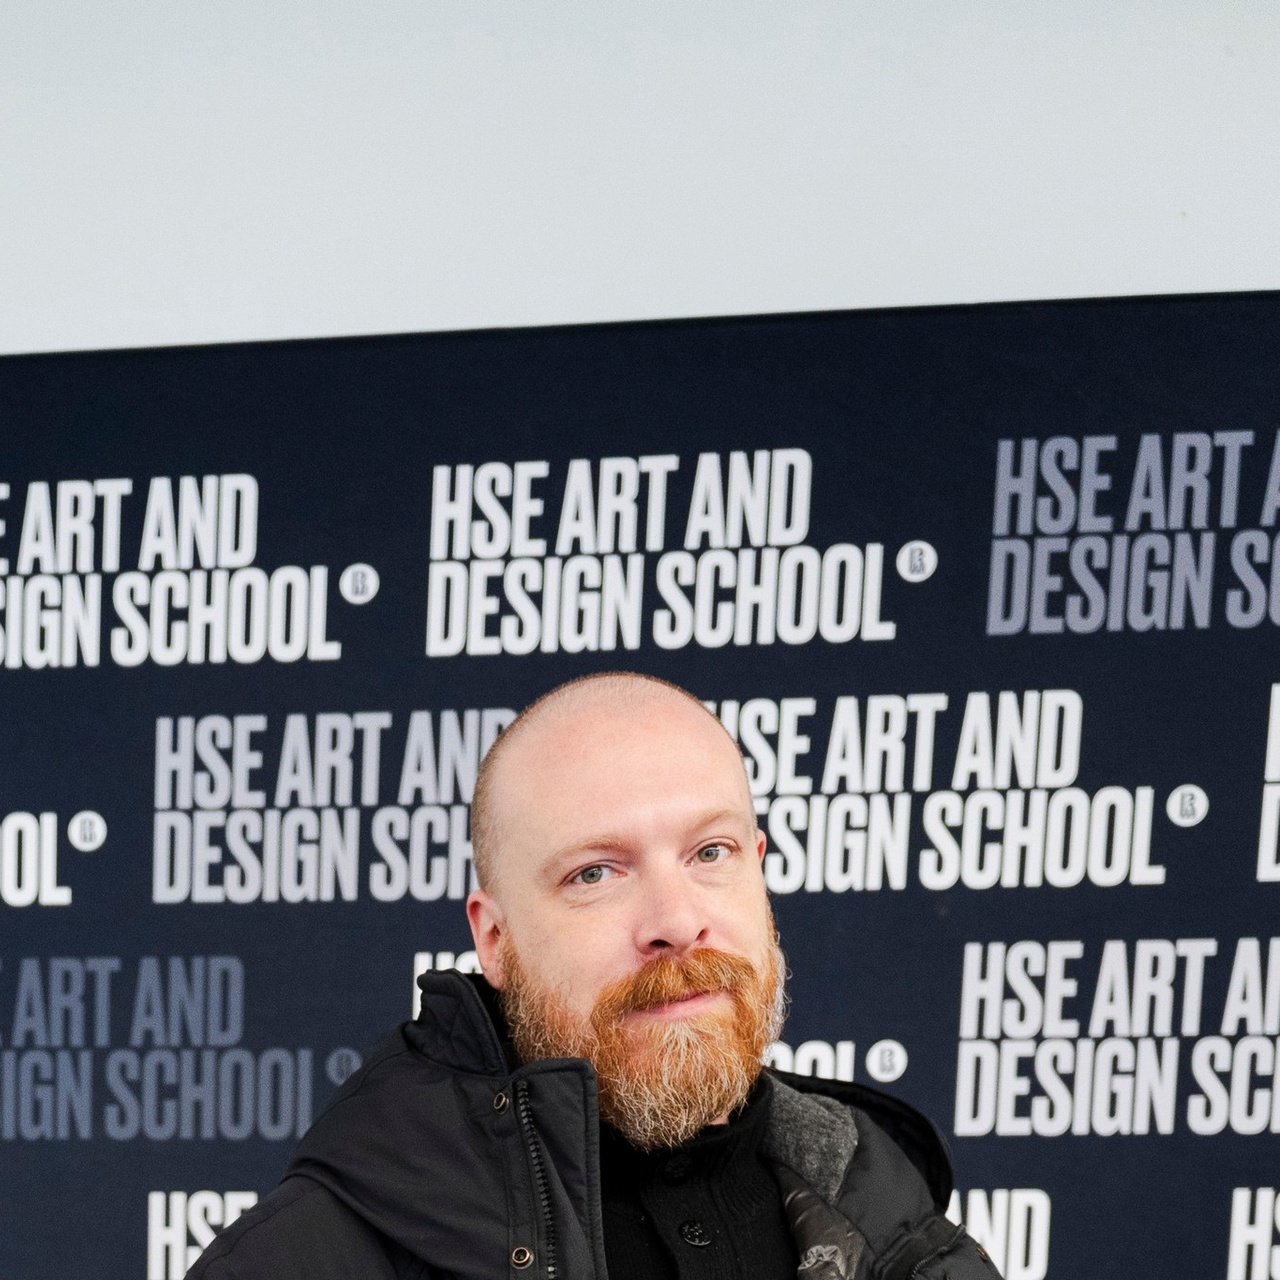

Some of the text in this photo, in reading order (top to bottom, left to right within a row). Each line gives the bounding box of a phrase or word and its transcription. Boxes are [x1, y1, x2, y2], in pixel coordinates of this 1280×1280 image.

[19, 479, 132, 575] ART
[139, 473, 259, 573] AND
[430, 448, 813, 560] HSE ART AND
[992, 435, 1118, 537] HSE
[1125, 431, 1255, 532] ART
[111, 566, 342, 667] SCHOOL
[426, 544, 897, 657] DESIGN SCHOOL
[985, 530, 1216, 637] DESIGN
[154, 715, 268, 811] HSE
[275, 711, 393, 809] ART
[705, 689, 1084, 796] SE ART AND
[152, 804, 475, 905] DESIGN SCH
[755, 793, 914, 896] SIGN
[919, 785, 1167, 891] SCHOOL
[11, 956, 121, 1049] ART
[130, 954, 246, 1048] AND
[959, 941, 1084, 1040] HSE
[1088, 937, 1218, 1038] ART
[953, 1036, 1180, 1138] DESIGN
